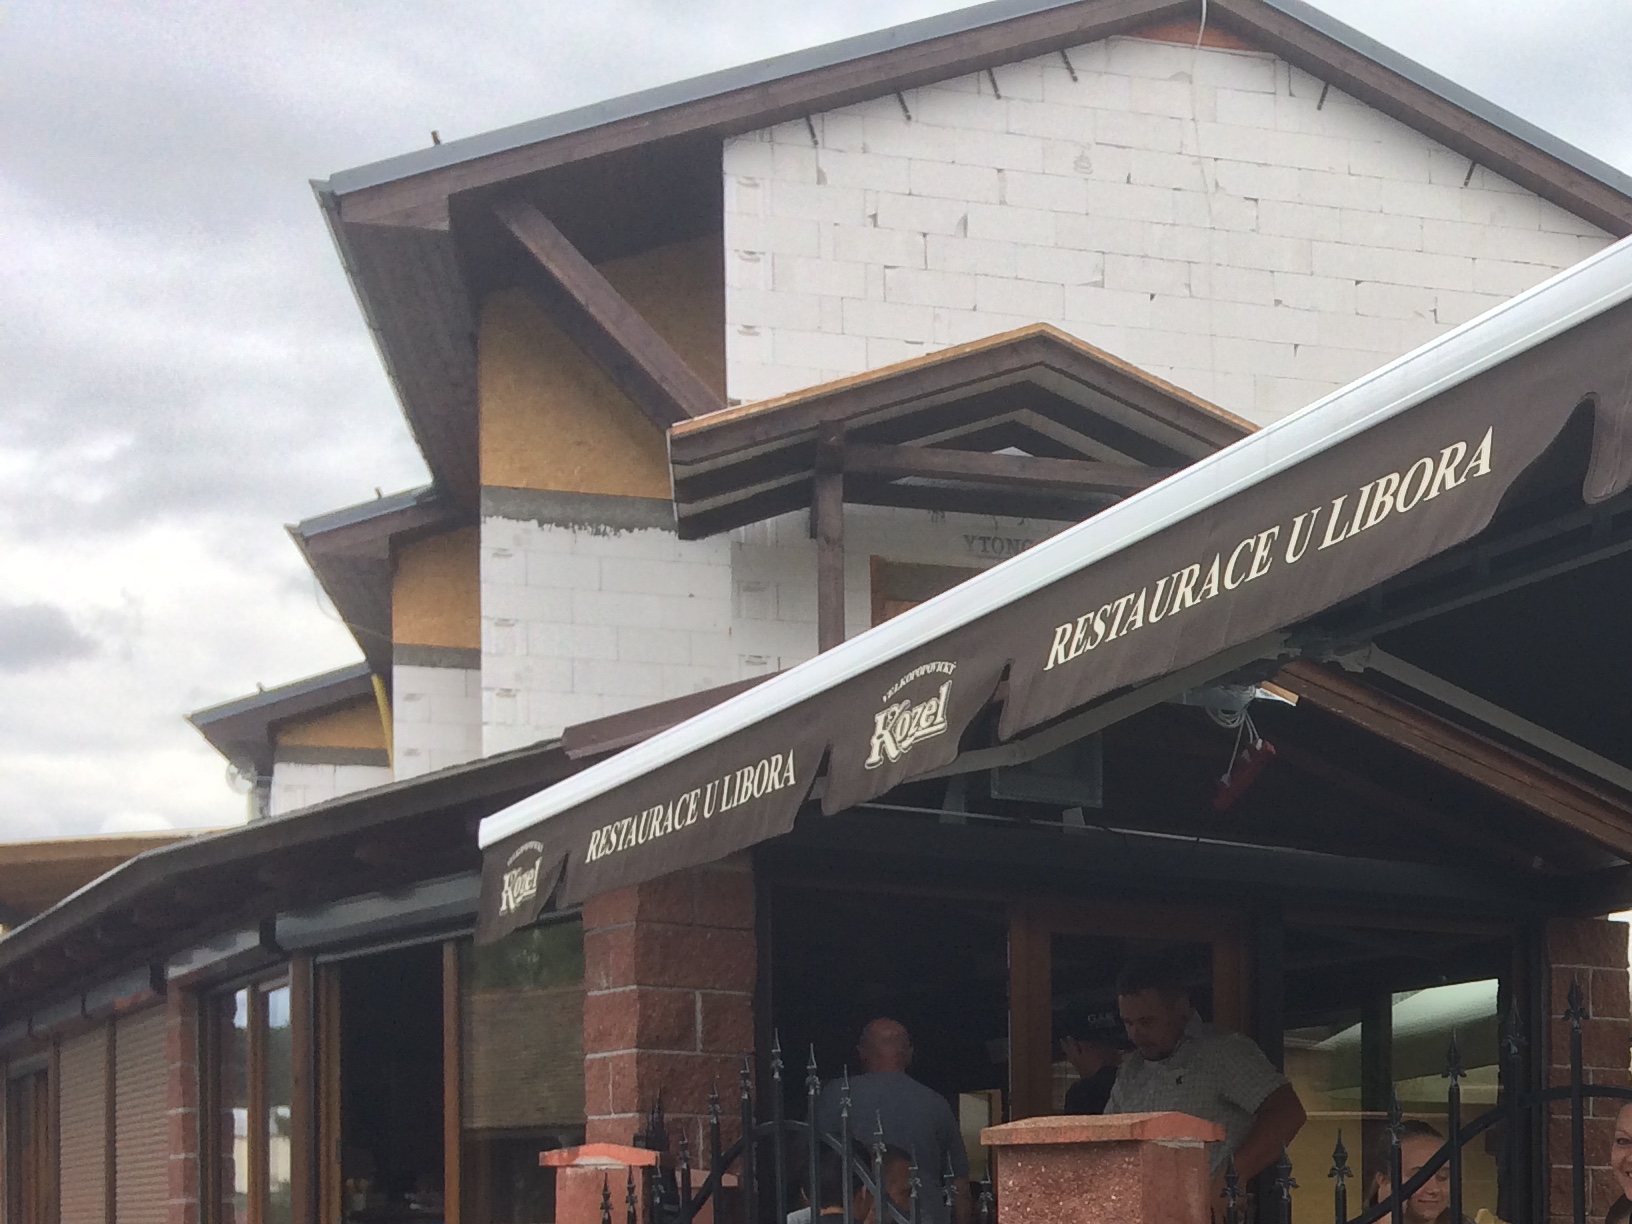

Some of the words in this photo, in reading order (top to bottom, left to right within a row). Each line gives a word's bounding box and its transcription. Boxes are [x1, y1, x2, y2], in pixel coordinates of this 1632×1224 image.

[1043, 525, 1281, 672] RESTAURACE
[1284, 506, 1320, 564] U
[1317, 425, 1496, 551] LIBORA
[864, 679, 953, 770] Kozel
[584, 787, 701, 864] RESTAURACE
[703, 779, 720, 819] U
[719, 748, 797, 814] LIBORA
[499, 856, 544, 917] Kozel
